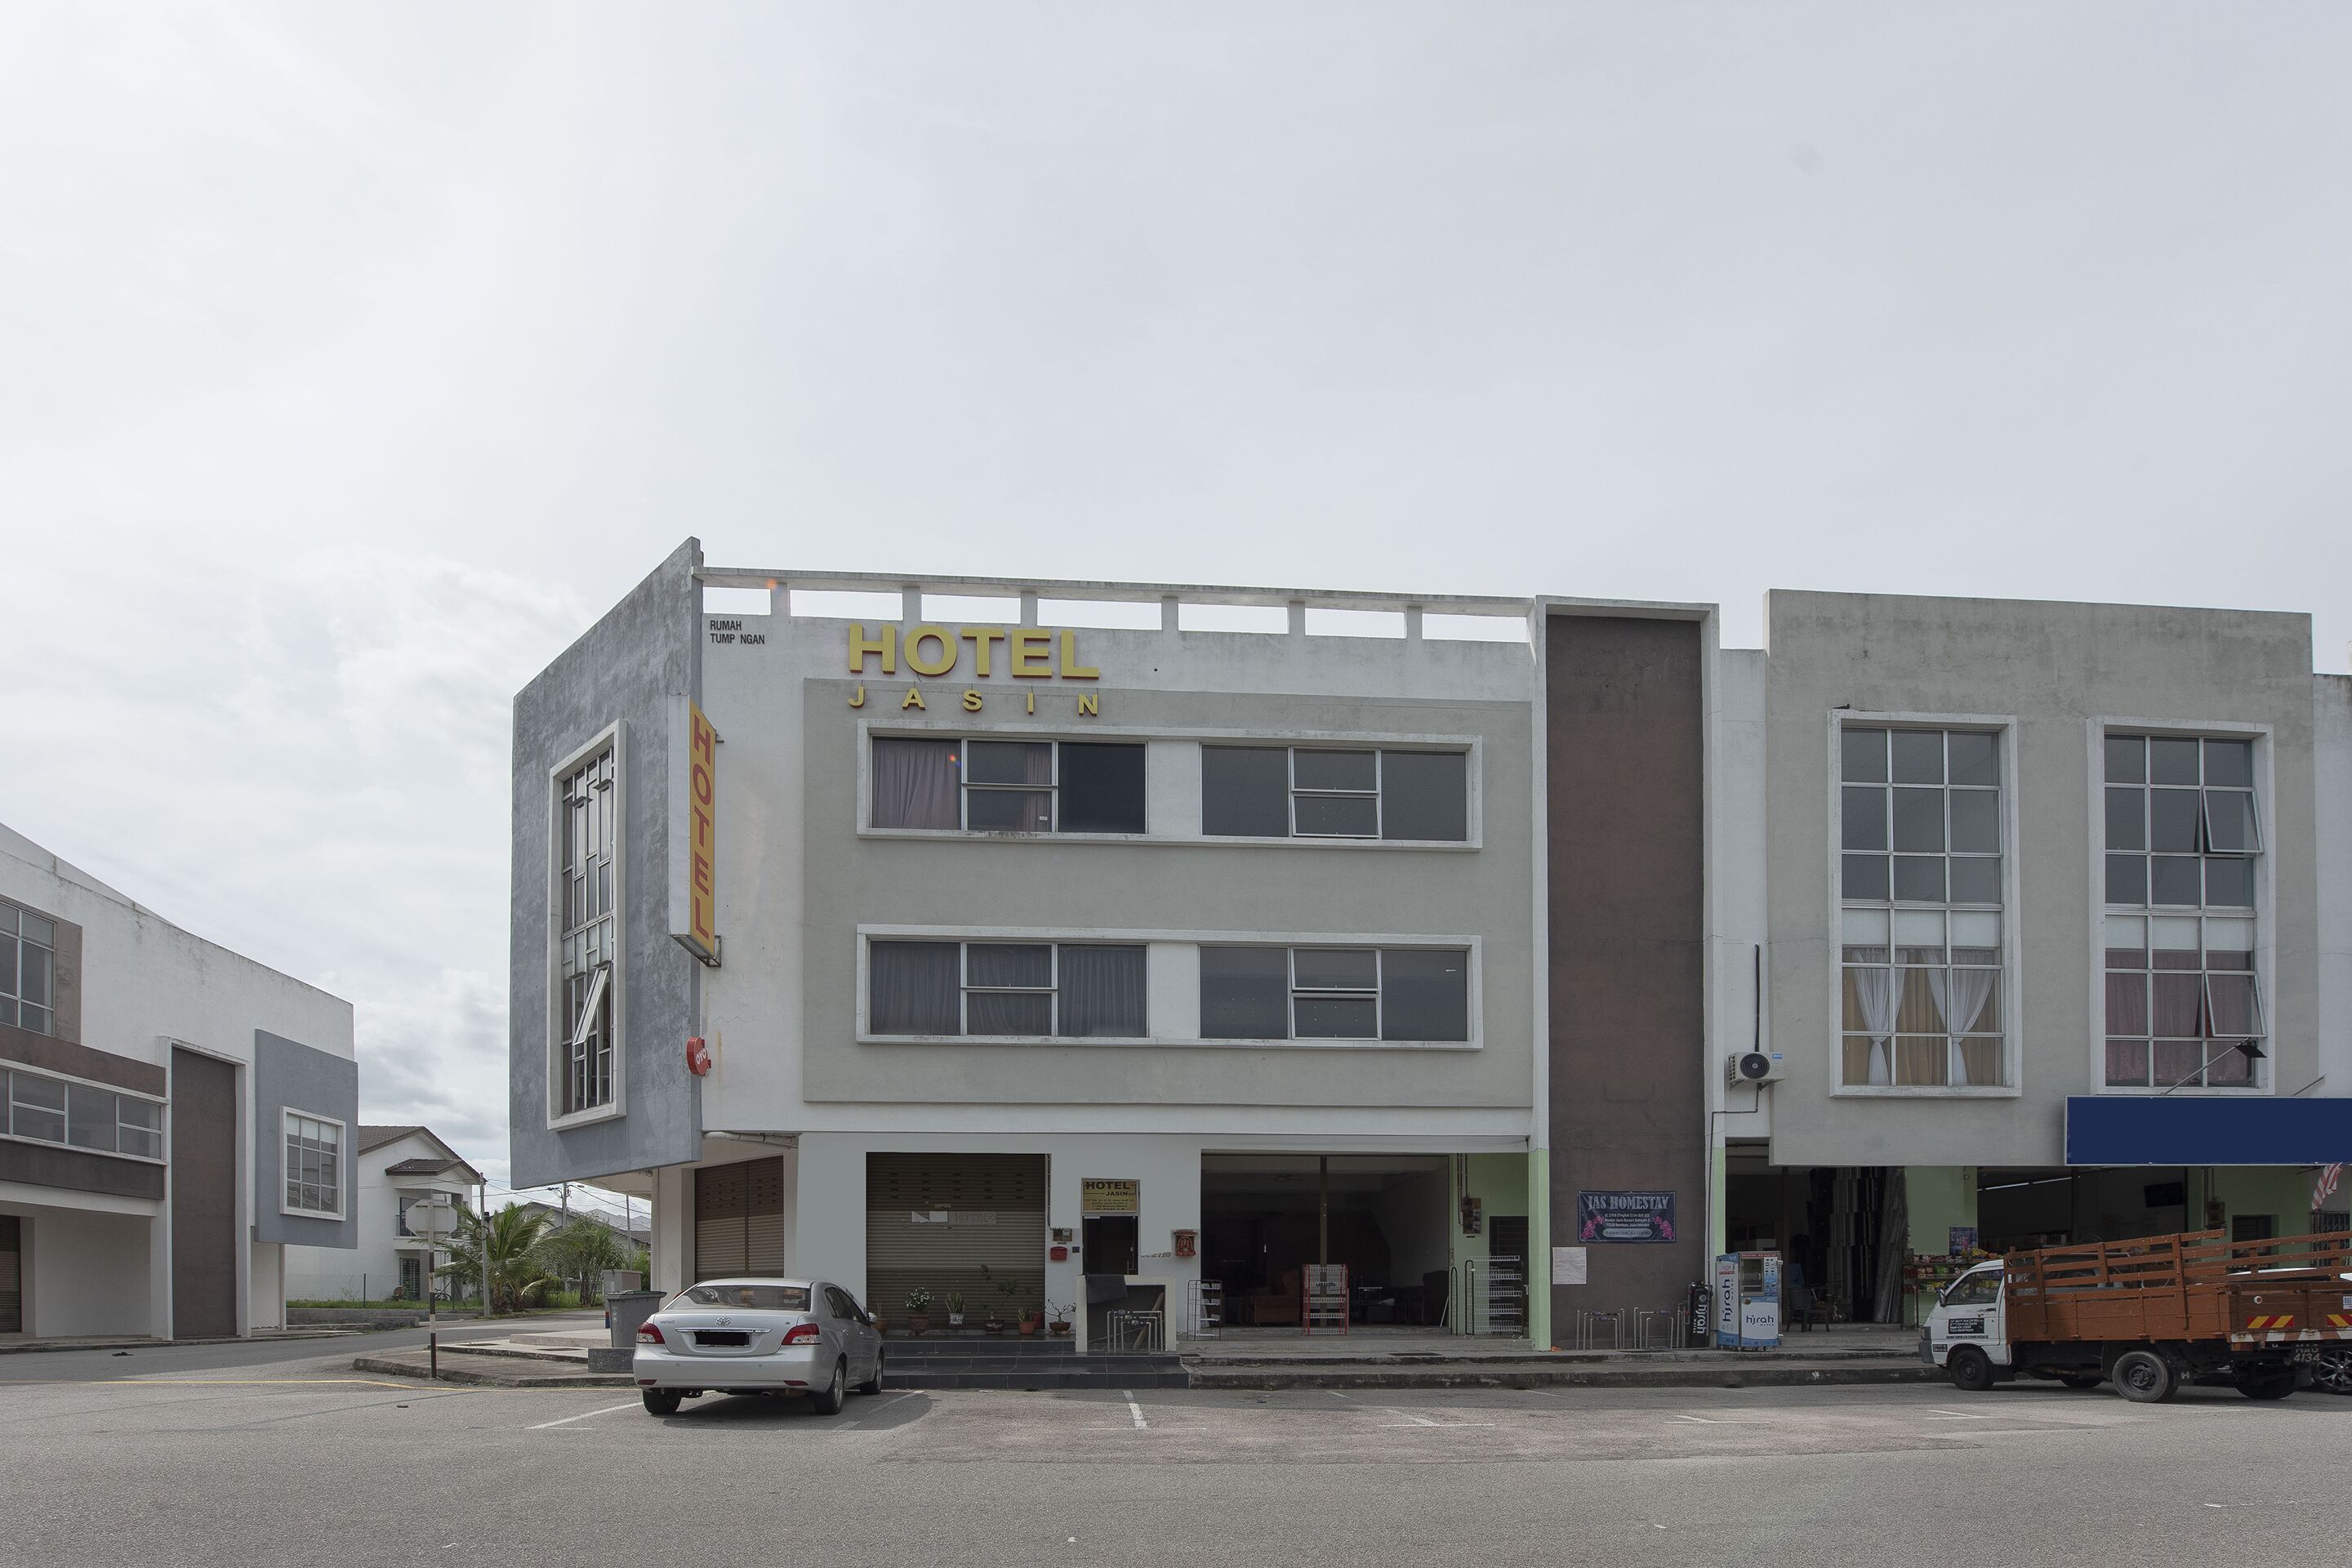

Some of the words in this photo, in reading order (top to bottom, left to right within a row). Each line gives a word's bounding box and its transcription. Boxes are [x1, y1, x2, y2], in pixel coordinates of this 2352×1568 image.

[710, 620, 742, 630] RUMAH
[849, 623, 1099, 679] HOTEL
[849, 685, 1098, 716] JASIN
[693, 714, 712, 940] HOTEL
[696, 1048, 707, 1065] OYO
[1085, 1181, 1130, 1190] HOTEL
[1588, 1196, 1606, 1210] JAS
[1610, 1196, 1668, 1209] HOMESTAY
[2293, 1353, 2321, 1362] 4134
